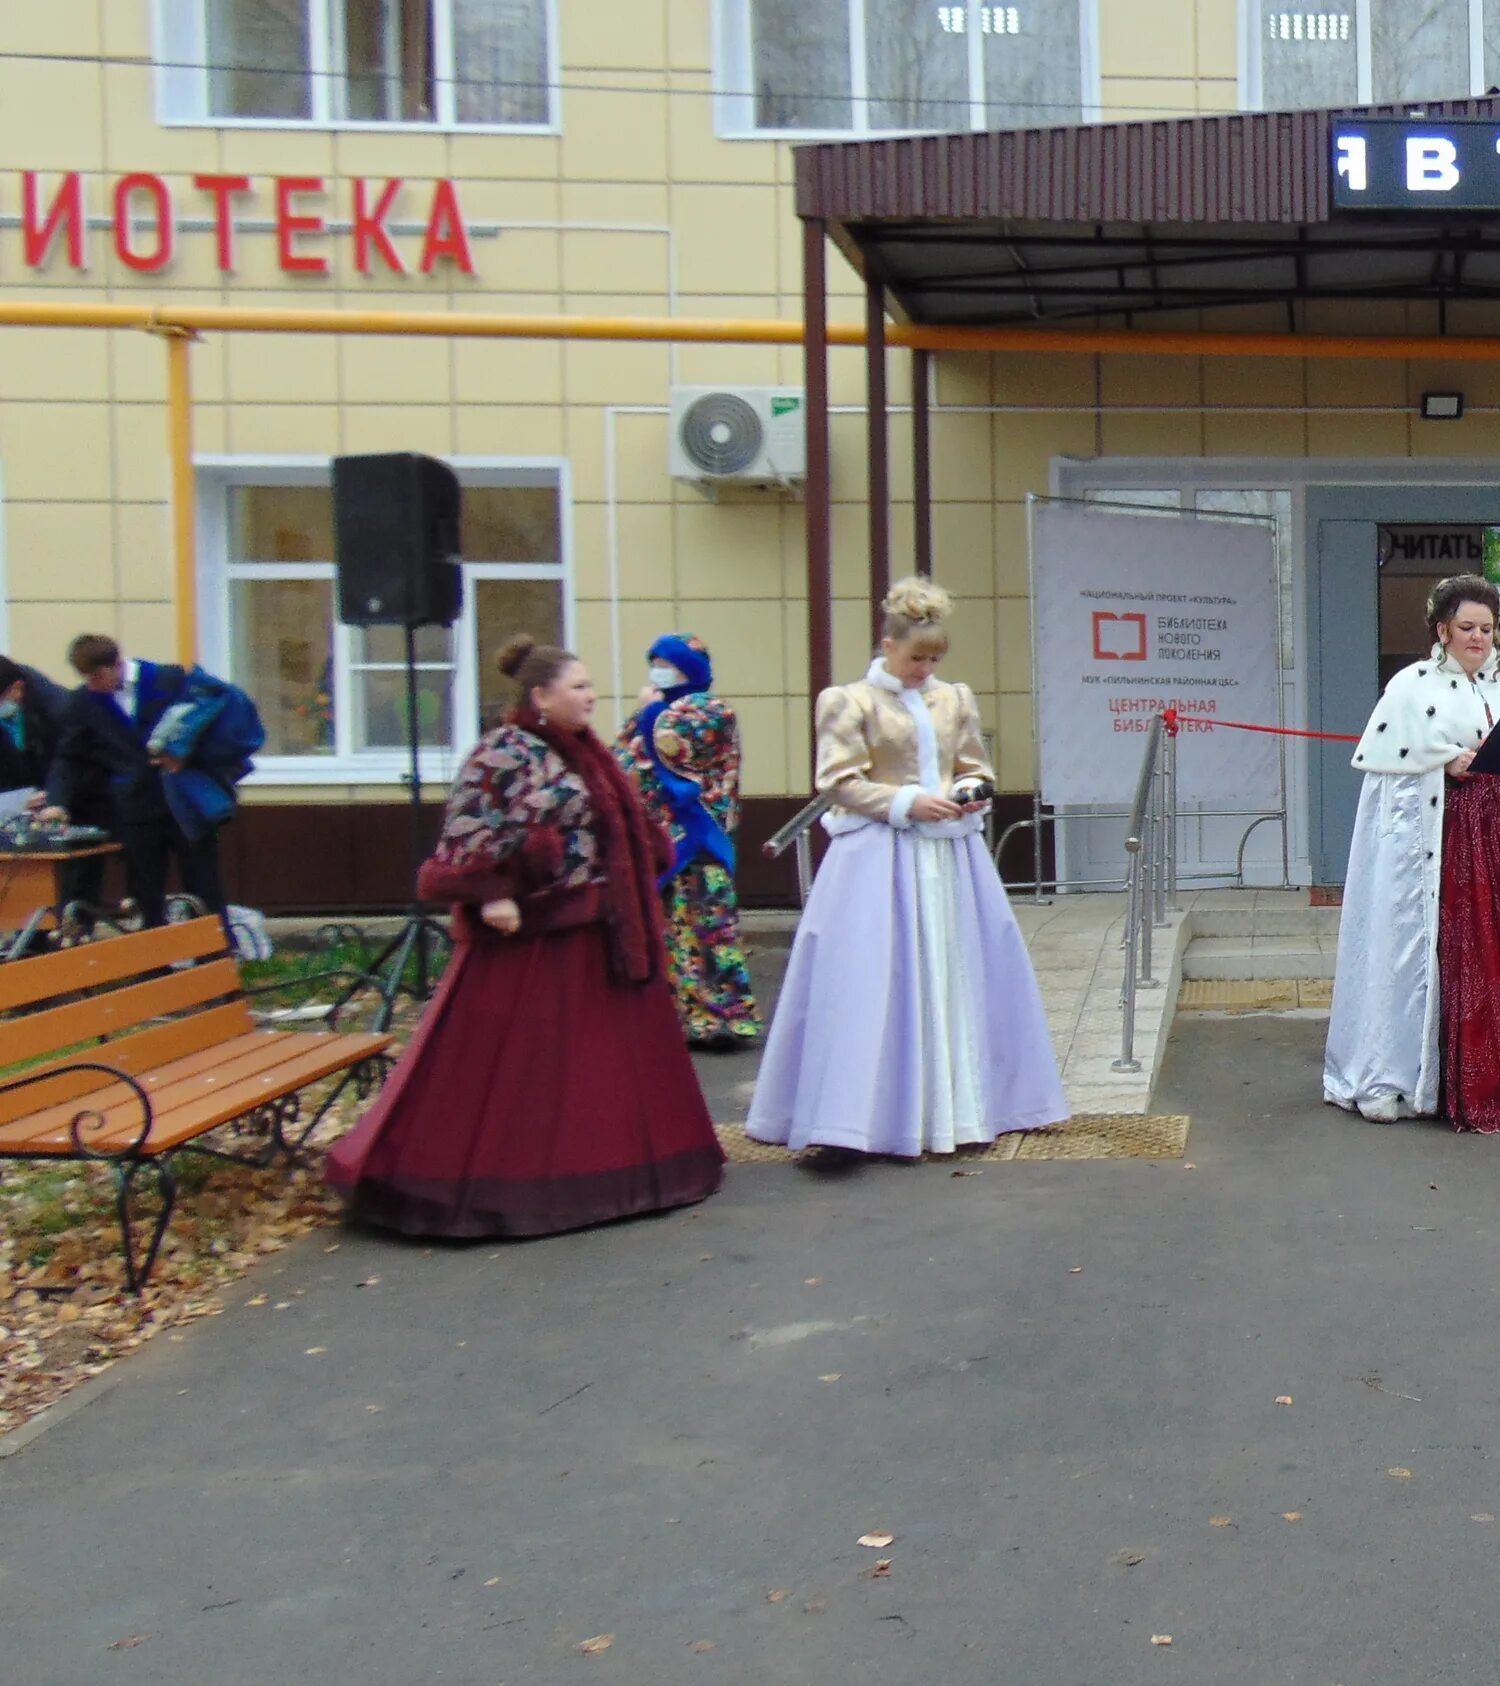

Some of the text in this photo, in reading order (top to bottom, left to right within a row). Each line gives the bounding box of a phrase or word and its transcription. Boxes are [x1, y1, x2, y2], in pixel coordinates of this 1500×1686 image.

[21, 170, 475, 274] ИОТЕКА
[1392, 533, 1482, 560] ЧИТАТЬ
[1080, 590, 1154, 601] НАЦИОНАЛЬНЫЙ
[1156, 593, 1188, 604] ПРОЕКТ
[1157, 616, 1228, 631] БИБЛИОТЕКА
[1158, 632, 1201, 645] НОВОГО
[1158, 647, 1221, 661] ПОКОЛЕНИЯ
[1081, 675, 1101, 685] МУК
[1173, 676, 1217, 686] РАЙОННАЯ
[1108, 698, 1217, 715] ЦЕНТРАЛЬНАЯ
[1113, 718, 1215, 733] БИБЛТЕКА
